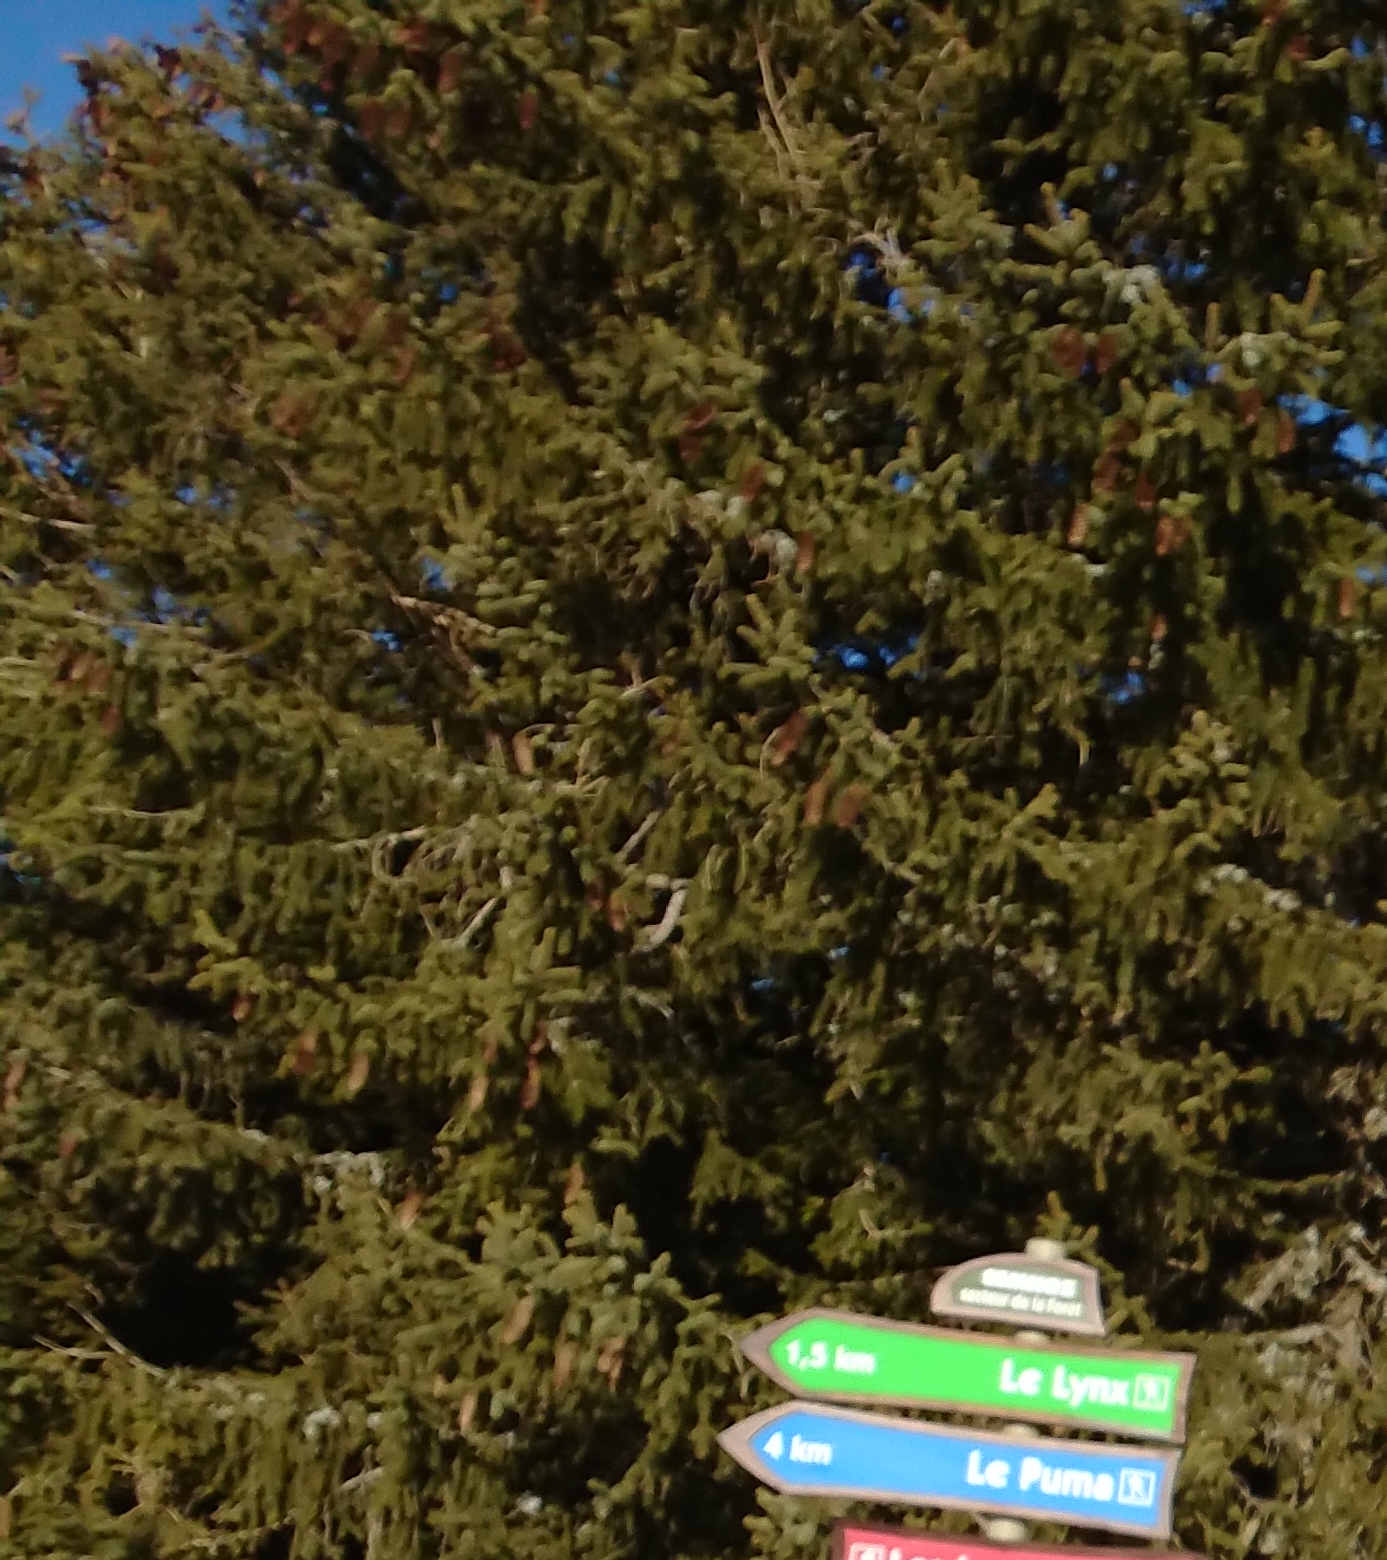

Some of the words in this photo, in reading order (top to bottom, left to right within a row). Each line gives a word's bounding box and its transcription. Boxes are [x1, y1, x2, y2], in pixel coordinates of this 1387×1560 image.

[785, 1338, 828, 1371] 1,5
[833, 1344, 876, 1376] km
[999, 1358, 1043, 1396] Le
[1052, 1365, 1129, 1407] Lynx
[762, 1431, 784, 1460] 4
[789, 1433, 833, 1465] km
[966, 1449, 1010, 1488] Le
[1019, 1457, 1114, 1502] Puma
